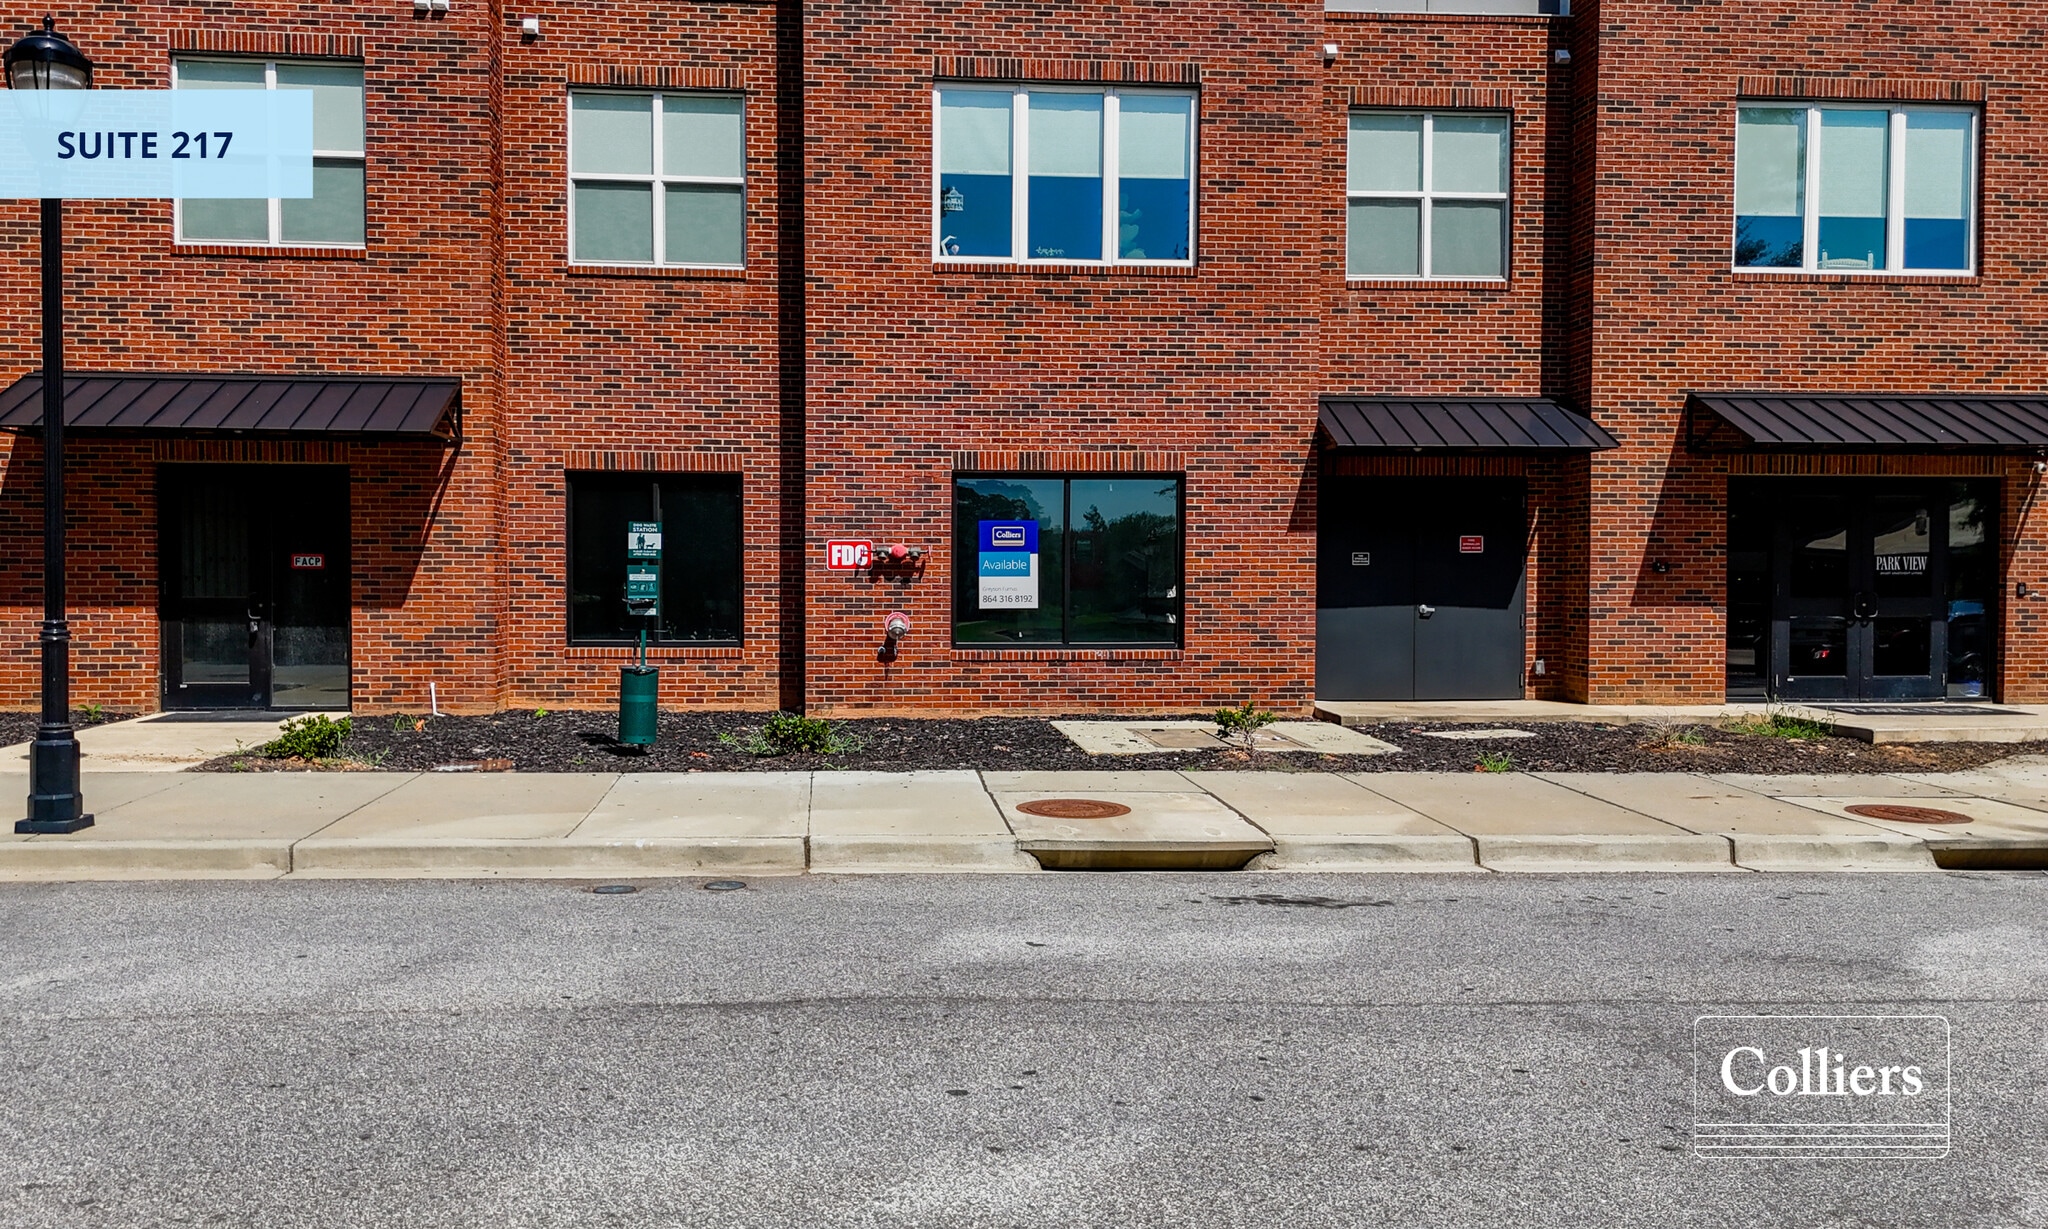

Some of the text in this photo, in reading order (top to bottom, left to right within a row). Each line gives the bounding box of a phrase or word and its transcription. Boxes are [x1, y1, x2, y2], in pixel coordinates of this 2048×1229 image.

[996, 530, 1021, 539] Colliers
[831, 545, 868, 566] FDC
[295, 557, 321, 566] FACP
[982, 560, 1027, 570] Available
[1876, 556, 1927, 570] PARK VIEW
[982, 595, 1033, 603] 864 316 8192
